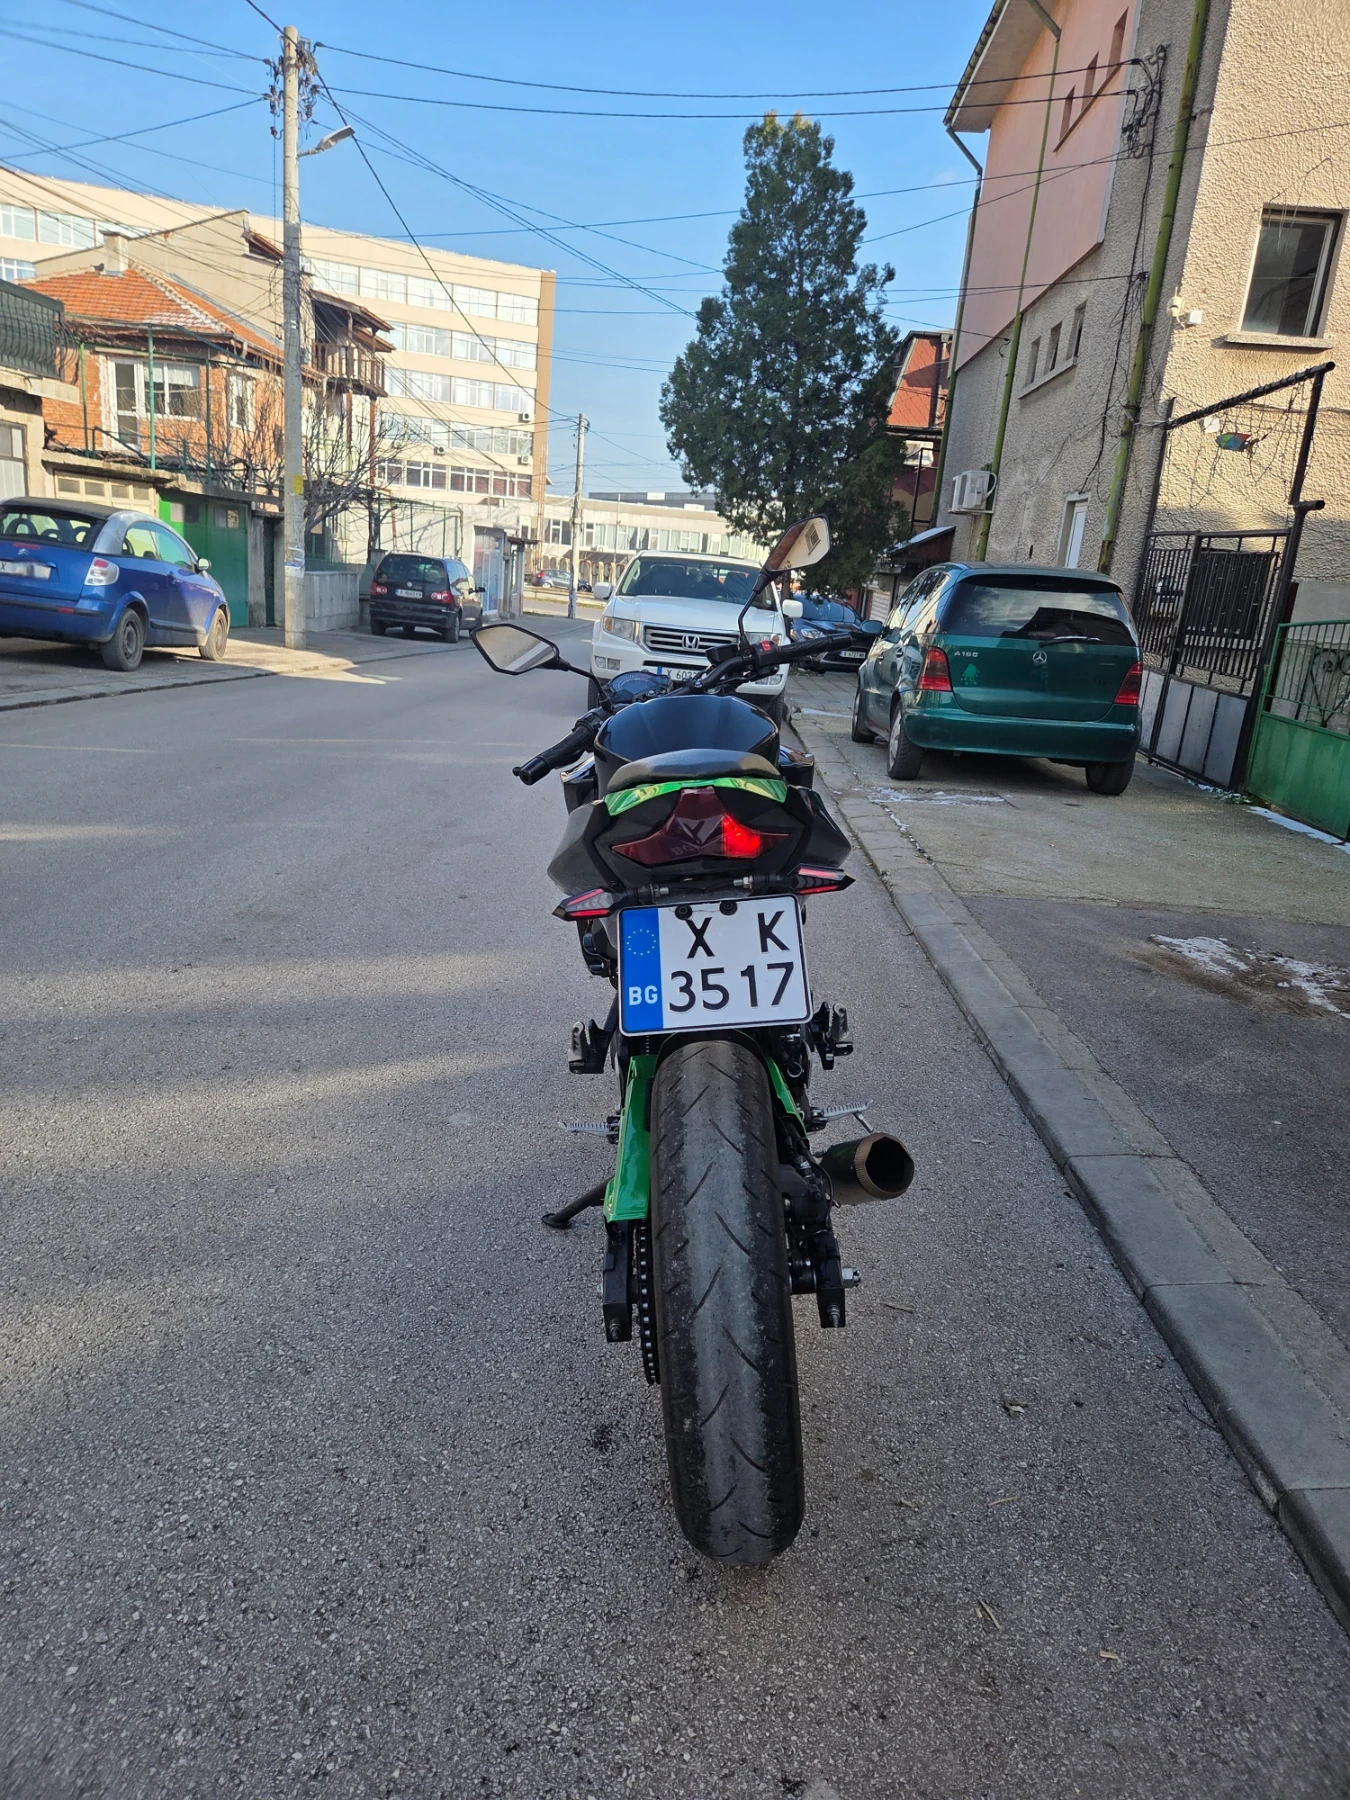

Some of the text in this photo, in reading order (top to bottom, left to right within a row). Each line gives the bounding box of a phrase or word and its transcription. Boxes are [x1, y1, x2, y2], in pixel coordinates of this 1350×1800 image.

[684, 910, 790, 960] X K
[628, 985, 658, 1006] BG
[668, 961, 794, 1013] 3517
